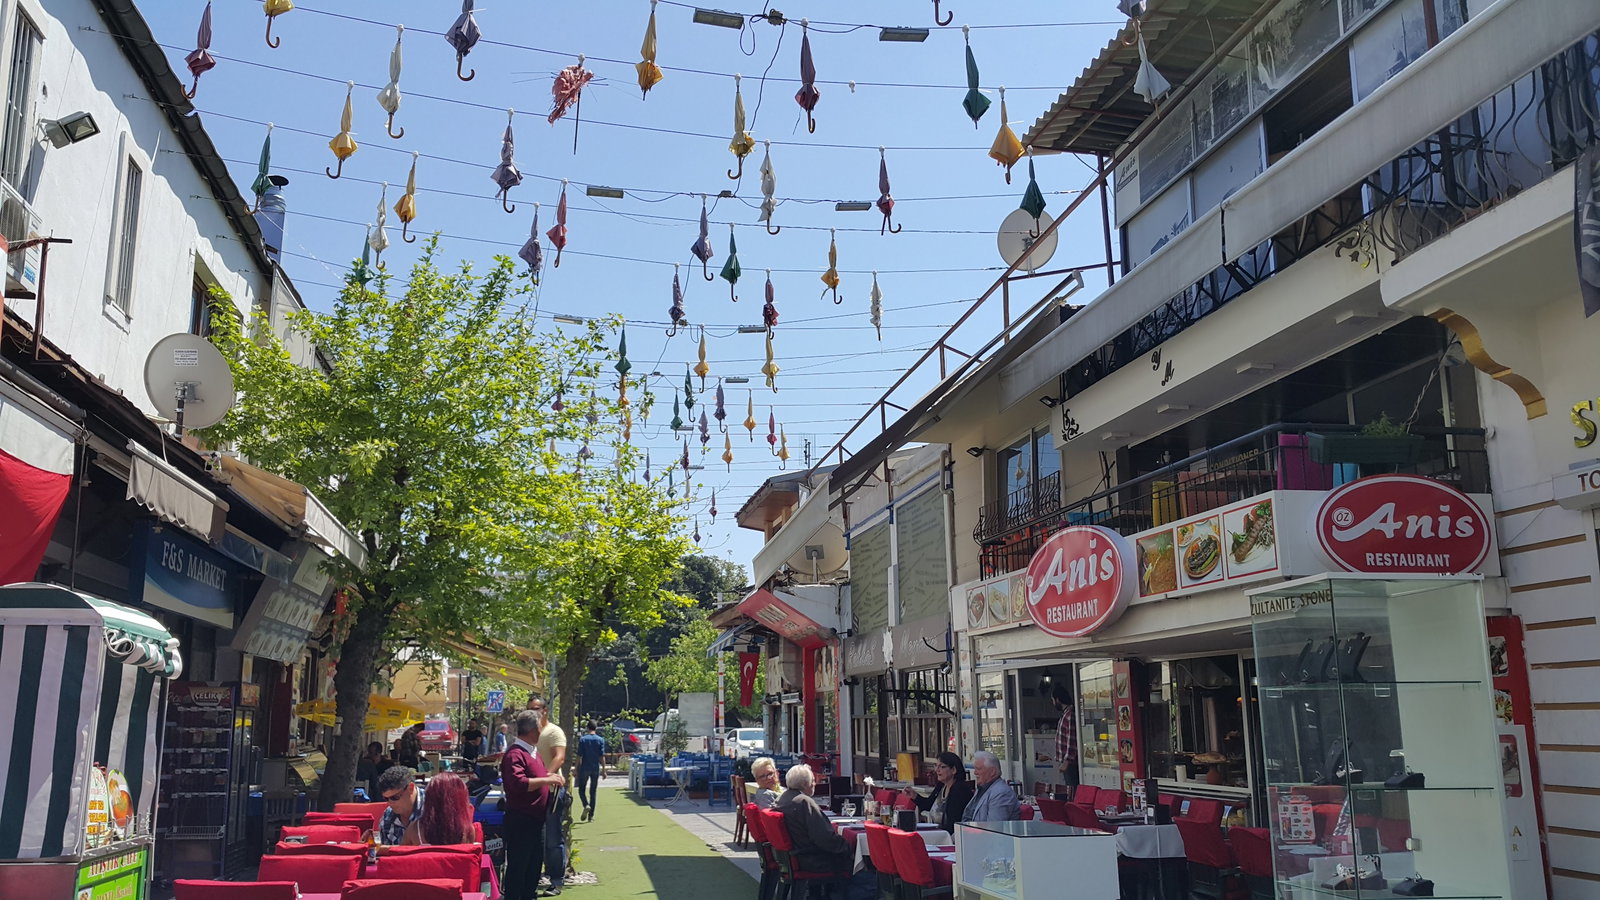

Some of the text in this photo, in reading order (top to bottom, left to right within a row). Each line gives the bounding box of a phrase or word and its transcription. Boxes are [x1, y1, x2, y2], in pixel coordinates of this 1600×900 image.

[1570, 396, 1600, 448] S
[1332, 502, 1475, 542] Anis
[161, 541, 227, 592] F&S MARKET
[1029, 538, 1114, 606] Anis
[1366, 552, 1450, 567] RESTAURANT
[1046, 599, 1098, 624] RESTAURANT
[1251, 588, 1332, 616] ZULTANITE STONE
